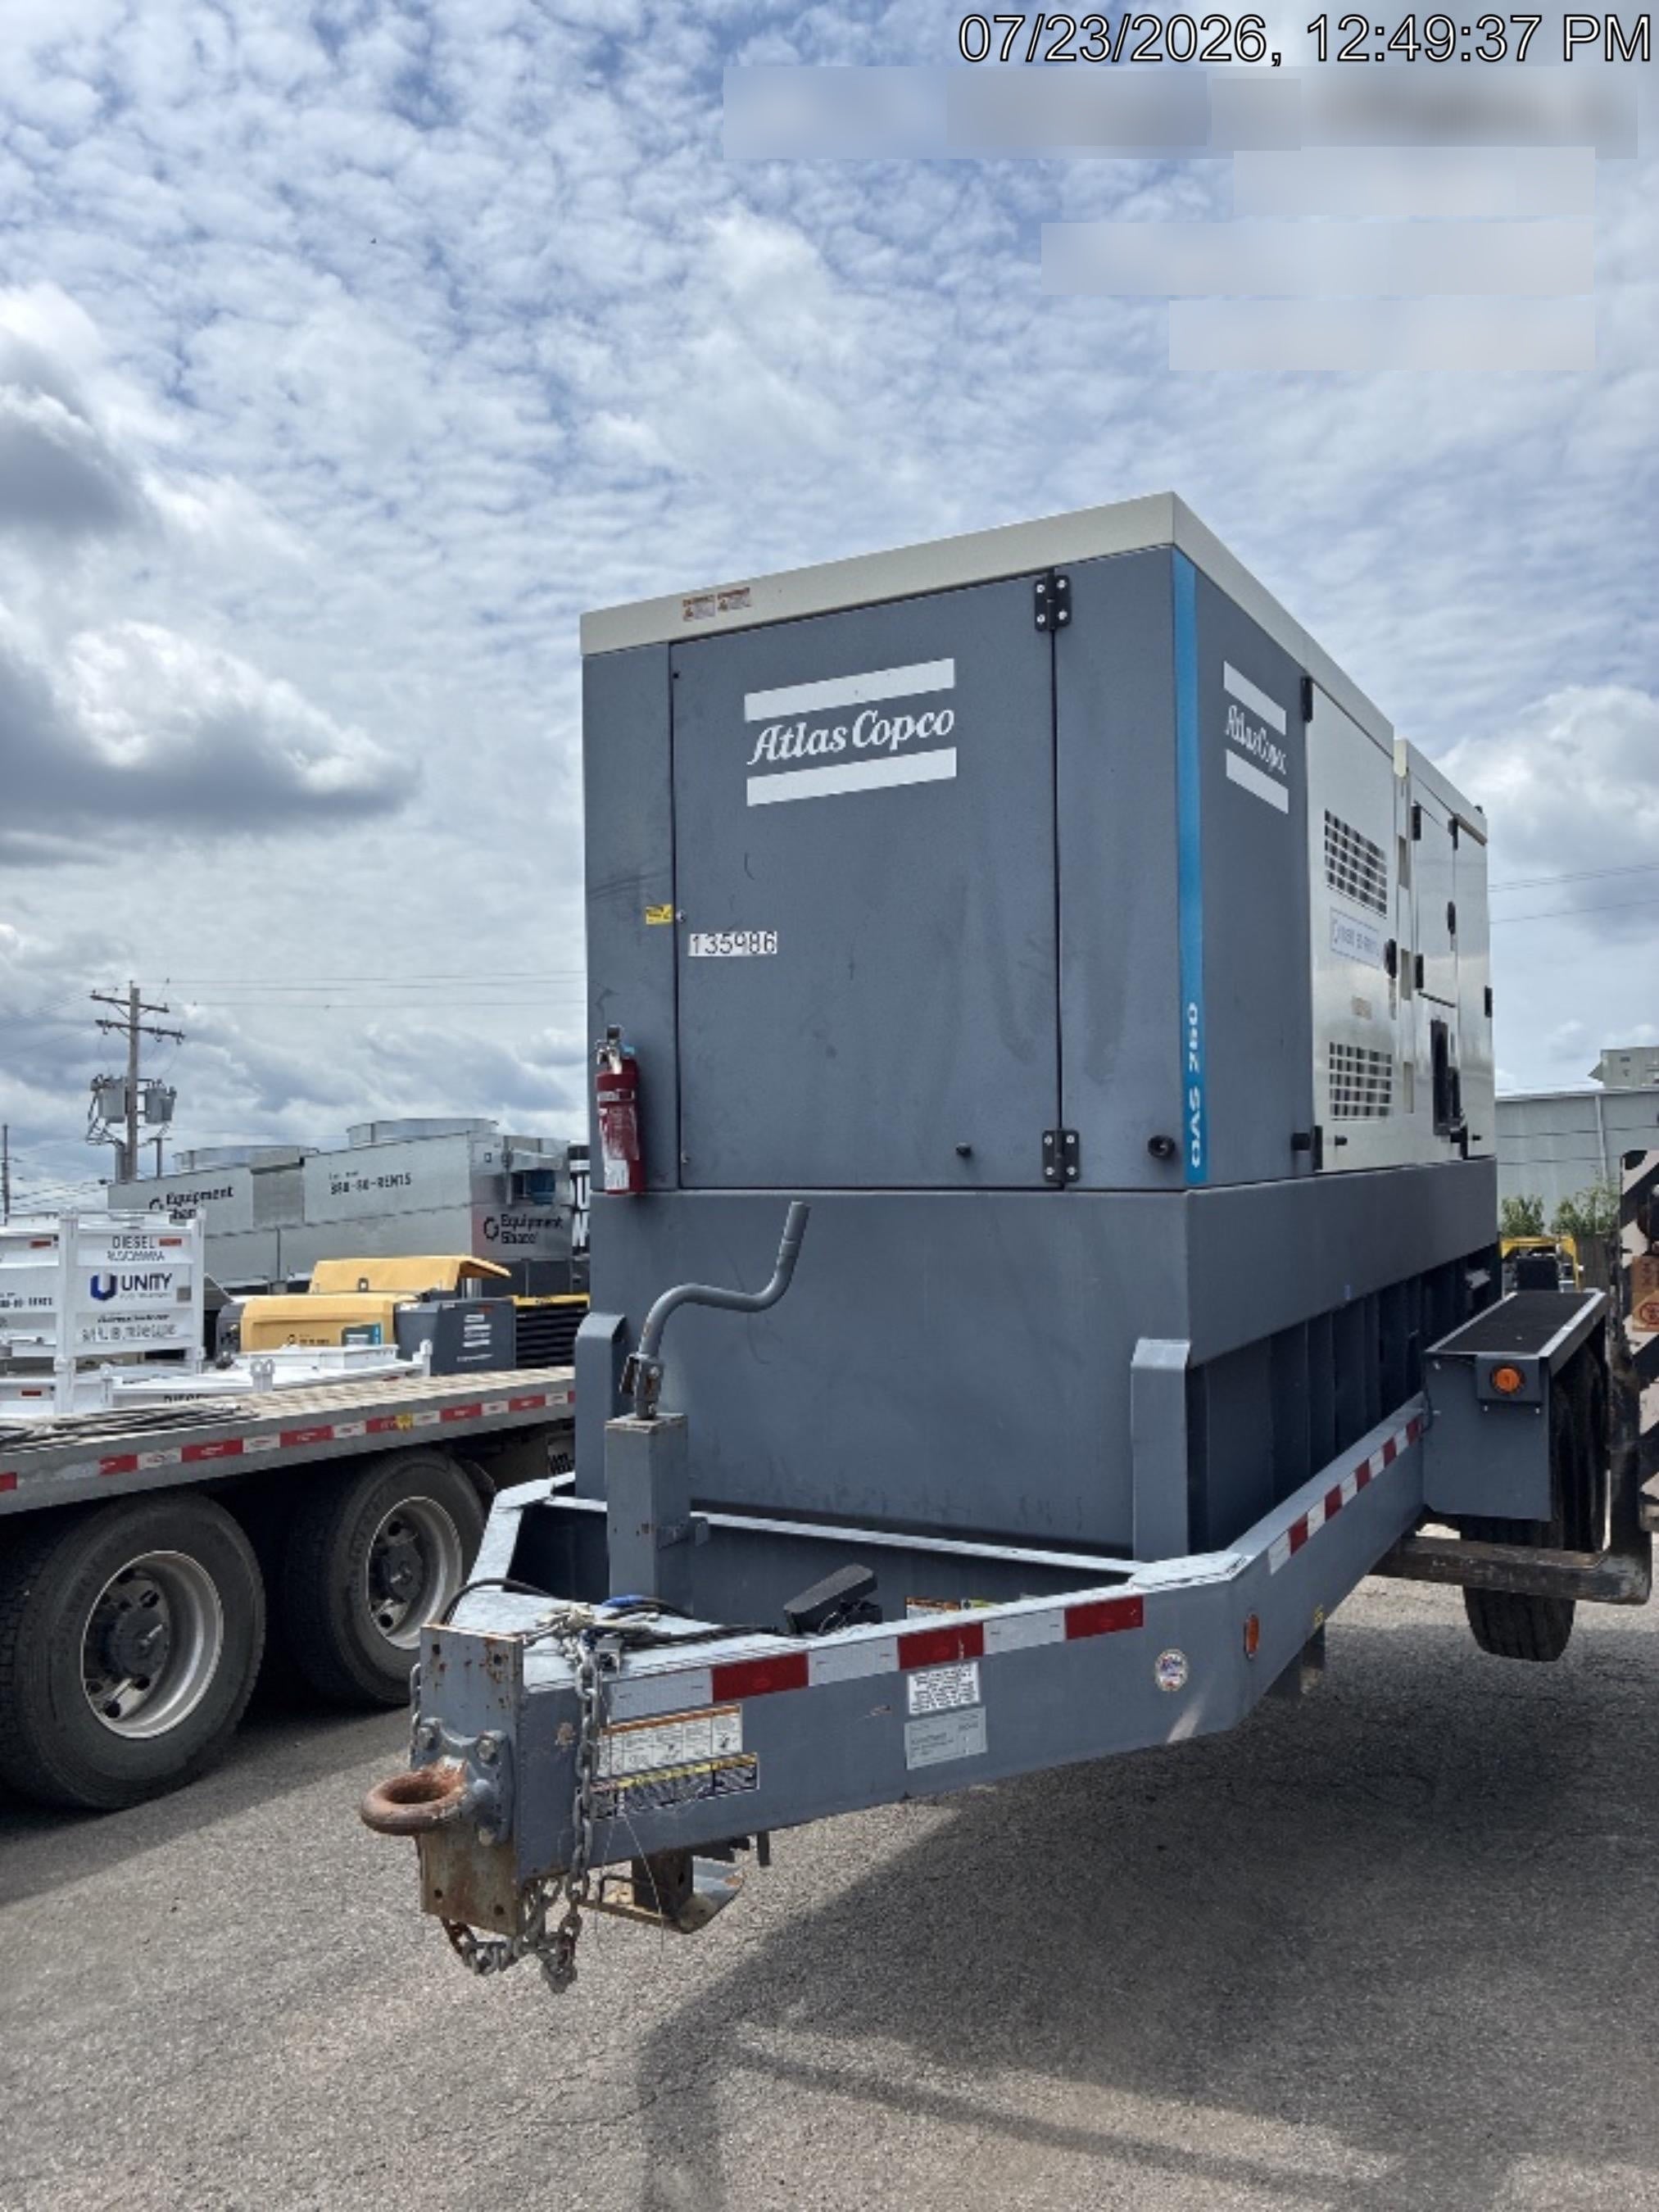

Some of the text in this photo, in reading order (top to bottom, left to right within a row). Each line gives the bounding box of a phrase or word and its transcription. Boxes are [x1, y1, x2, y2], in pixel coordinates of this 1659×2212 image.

[746, 709, 954, 765] Atlas Copco
[693, 931, 775, 954] 135986
[112, 1235, 156, 1249] DIESEL
[122, 1273, 172, 1292] UNITY
